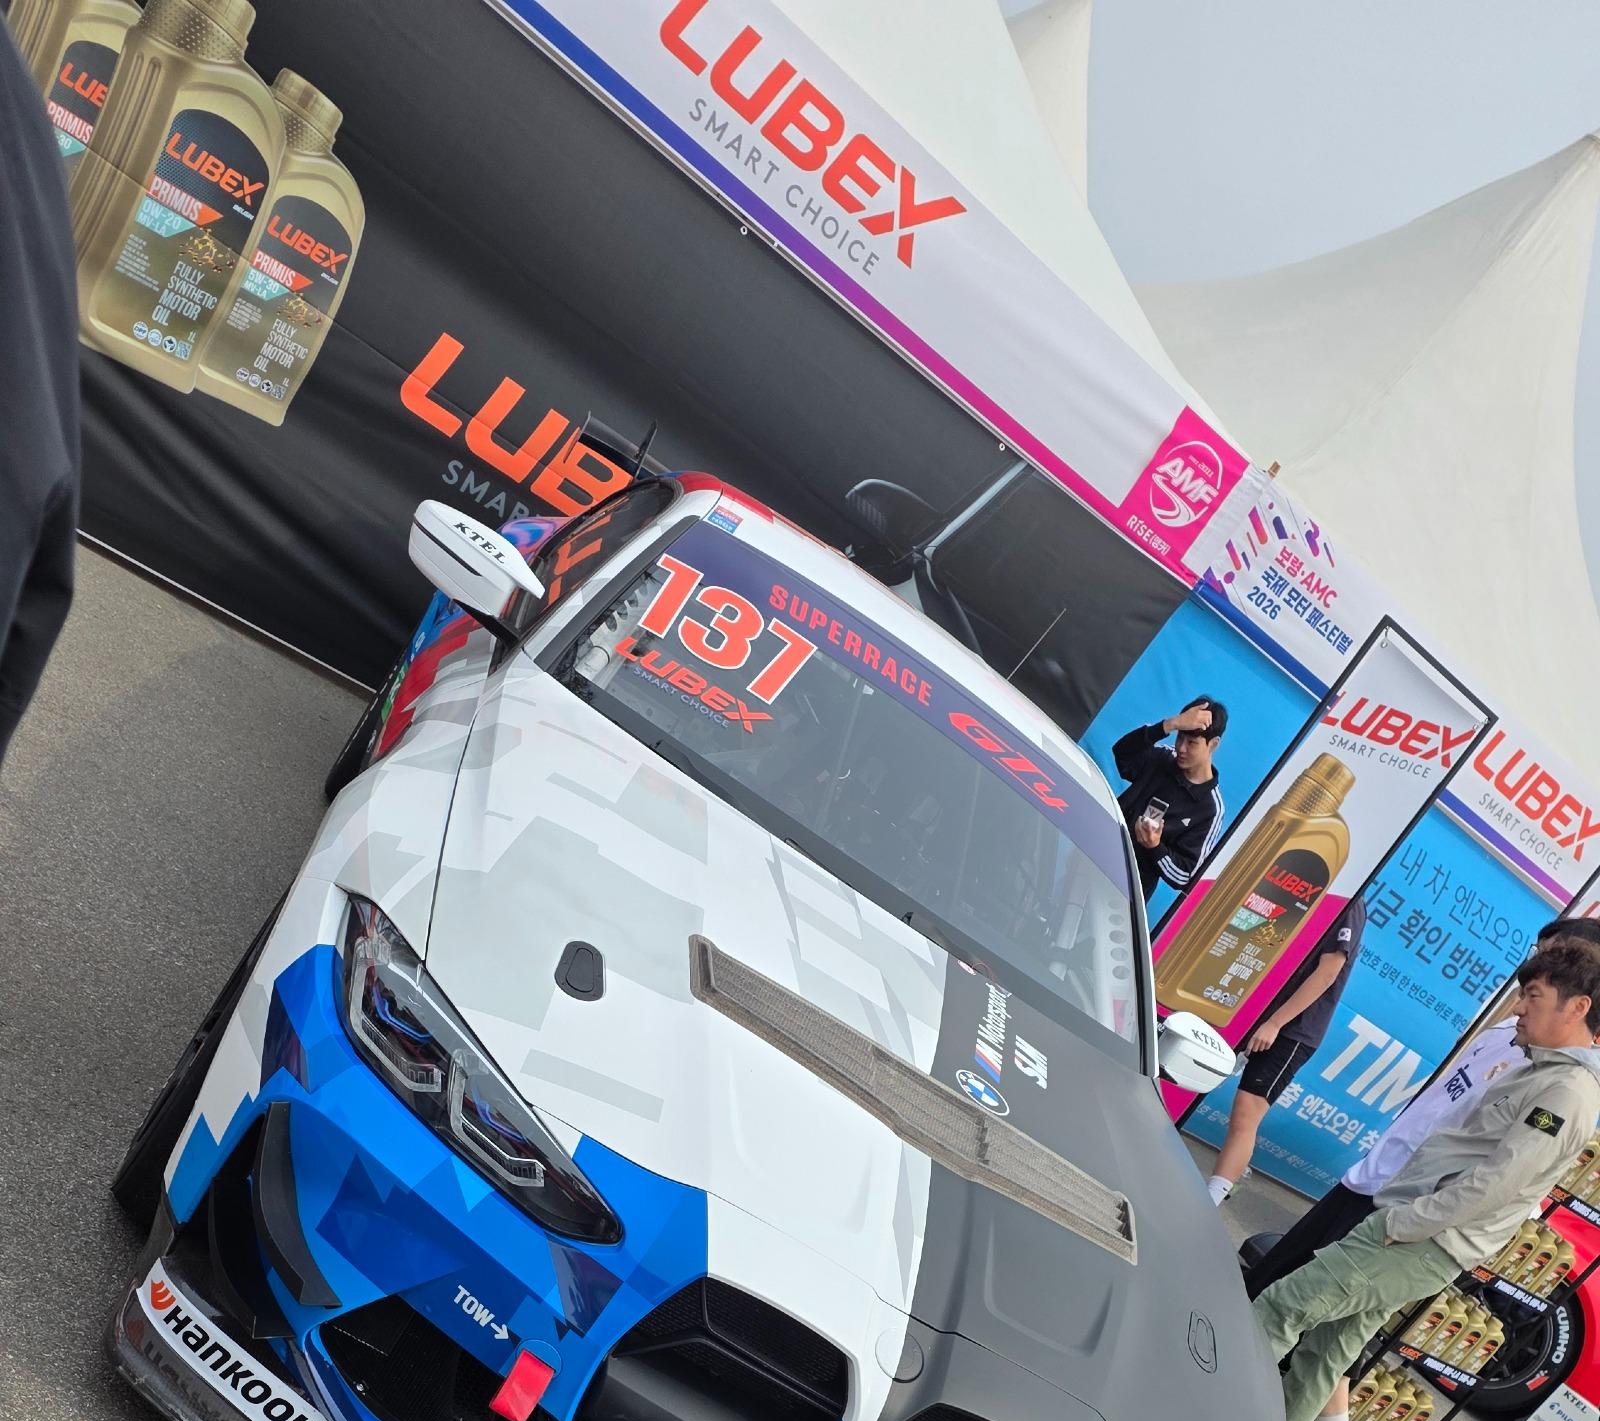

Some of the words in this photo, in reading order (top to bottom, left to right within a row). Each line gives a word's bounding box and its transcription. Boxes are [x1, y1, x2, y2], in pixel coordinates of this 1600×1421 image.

[660, 0, 967, 269] LUBEX
[165, 132, 264, 207] LUBEX
[689, 99, 780, 184] SMART
[785, 185, 880, 276] CHOICE
[150, 175, 203, 221] PRIMUS
[253, 250, 296, 287] PRIMUS
[267, 215, 348, 274] LUBEX
[167, 275, 218, 310] SYNTHETIC
[173, 260, 205, 285] FULLY
[151, 305, 171, 326] OIL
[159, 288, 201, 321] MOTOR
[272, 318, 297, 339] FULLY
[253, 355, 270, 373] OIL
[260, 342, 294, 369] MOTOR
[267, 330, 308, 359] SYNTHETIC
[442, 459, 538, 521] SMAR
[1156, 457, 1219, 504] AMF
[452, 521, 506, 564] KTEL
[1246, 586, 1281, 620] 2026
[1261, 566, 1290, 598] 국제
[1282, 587, 1312, 618] 모터
[1305, 607, 1354, 655] 페스티벌
[638, 553, 818, 706] 137
[769, 584, 934, 707] SUPERRACE
[615, 636, 774, 734] LUBEX
[633, 667, 679, 695] SMART
[681, 694, 730, 728] CHOICE
[1320, 691, 1477, 769] LUBEX
[1329, 734, 1376, 758] SMART
[1379, 753, 1432, 779] CHOICE
[1473, 729, 1600, 863] LUBEX
[1479, 793, 1521, 832] SMART
[1519, 828, 1564, 870] CHOICE
[1265, 865, 1323, 902] LUBEX
[1400, 843, 1428, 887] 내
[1424, 863, 1451, 905] 차
[1449, 884, 1530, 968] 엔진오일
[1397, 908, 1453, 965] 확인
[1359, 945, 1382, 971] 번호
[1379, 962, 1401, 985] 입력
[1410, 979, 1436, 1009] 번으로
[1435, 1002, 1454, 1021] 바로
[977, 983, 1012, 1051] Motorsport
[1192, 1029, 1225, 1055] KTEL
[1296, 1094, 1366, 1145] 엔진오일
[453, 1285, 494, 1329] TOW
[1563, 1390, 1587, 1414] KTEL
